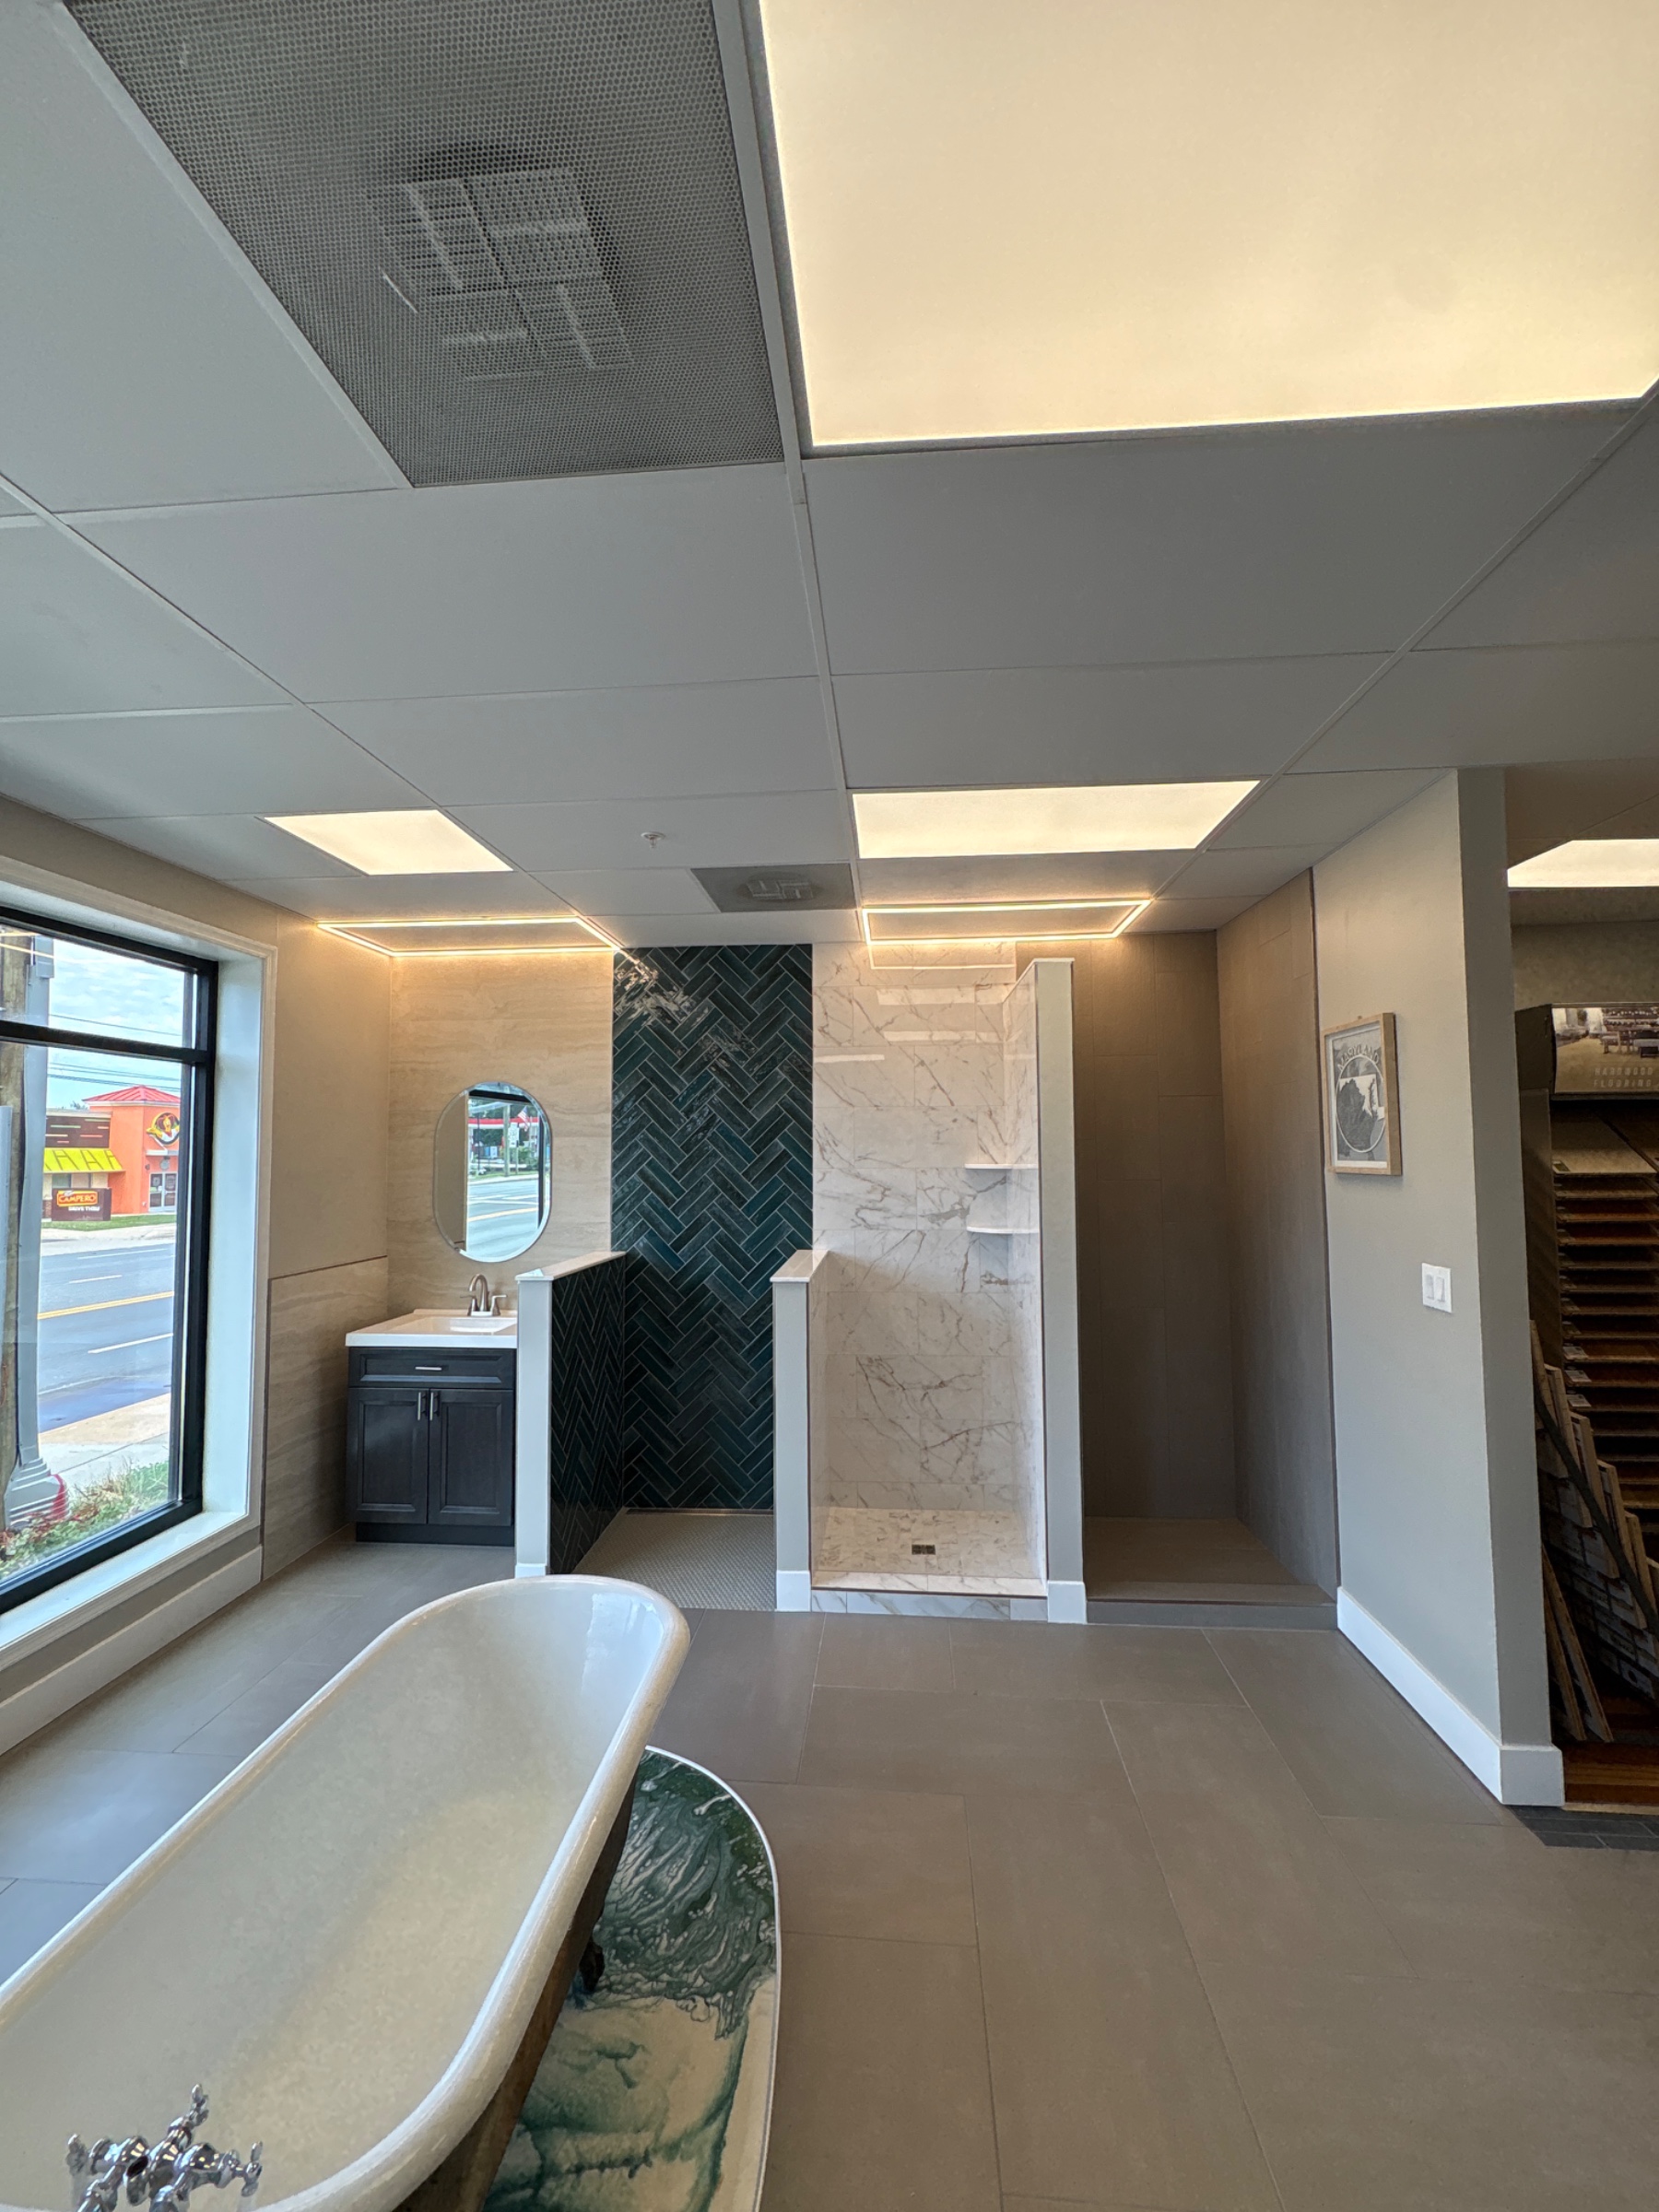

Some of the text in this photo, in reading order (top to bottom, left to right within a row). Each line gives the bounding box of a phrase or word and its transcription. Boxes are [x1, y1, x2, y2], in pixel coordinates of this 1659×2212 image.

[1337, 1044, 1380, 1070] MARYLAND
[1594, 1066, 1653, 1077] HARDWOOD
[1594, 1078, 1652, 1088] FLOORING
[58, 1194, 96, 1203] CAMPERO
